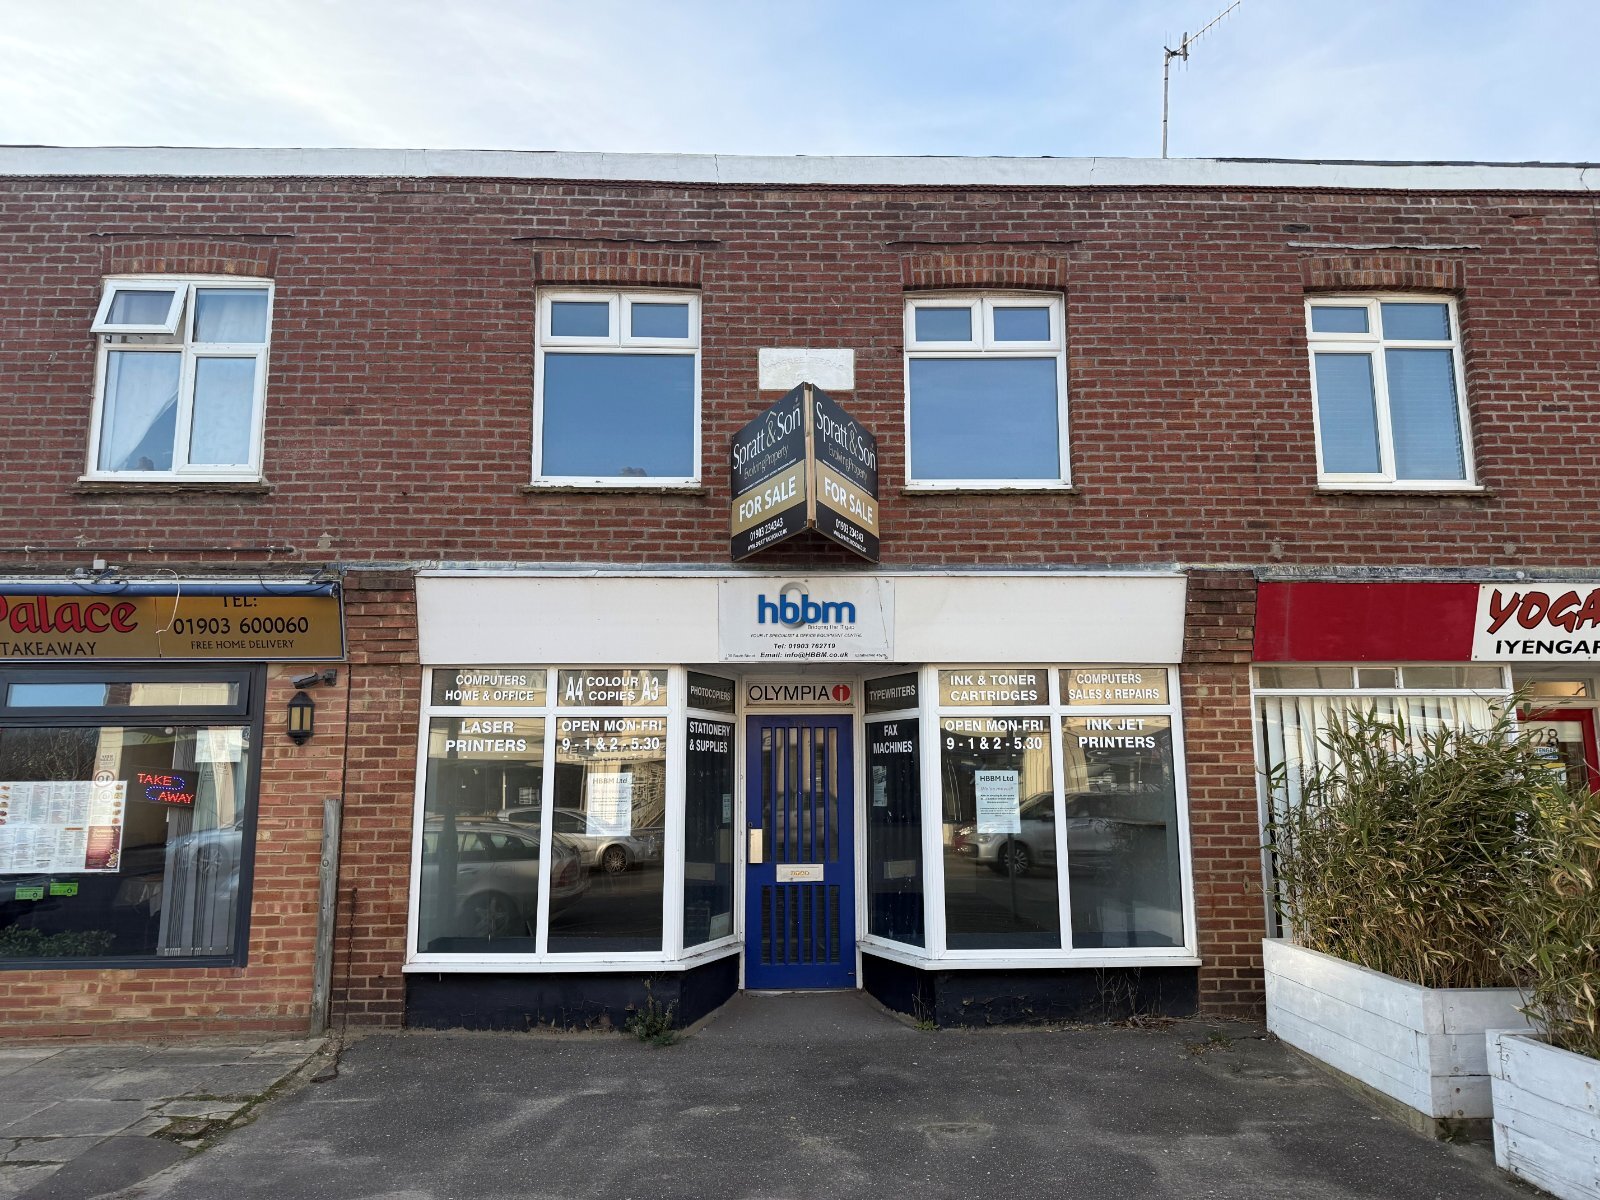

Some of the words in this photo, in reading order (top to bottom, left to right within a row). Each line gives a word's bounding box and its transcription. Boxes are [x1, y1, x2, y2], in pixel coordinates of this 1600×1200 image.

[733, 428, 765, 475] Spratt
[766, 411, 777, 447] &
[777, 407, 800, 441] Son
[816, 401, 848, 451] Spratt
[849, 422, 858, 457] &
[858, 435, 876, 472] Son
[739, 495, 762, 522] FOR
[764, 475, 796, 510] SALE
[824, 476, 847, 508] FOR
[849, 493, 873, 525] SALE
[749, 525, 765, 542] 01903
[758, 594, 856, 624] hbbm
[1486, 587, 1600, 635] YOGA
[173, 617, 231, 635] 01903
[239, 616, 309, 634] 600060
[0, 641, 97, 656] TAKEAWAY
[191, 640, 214, 649] FREE
[216, 640, 246, 649] HOME
[249, 639, 294, 649] DELIVERY
[784, 651, 849, 659] info@HBBM.co.uk
[455, 674, 527, 686] COMPUTERS
[586, 676, 639, 687] COLOUR
[950, 674, 974, 686] INK
[977, 675, 987, 686] &
[989, 674, 1036, 686] TONER
[1076, 673, 1142, 684] COMPUTERS
[445, 689, 480, 701] HOME
[482, 690, 490, 701] &
[493, 690, 535, 701] OFFICE
[565, 676, 583, 701] A4
[641, 676, 660, 701] A3
[690, 685, 731, 701] PHOTOCOPIERS
[749, 685, 830, 701] OLYMPIA
[868, 684, 916, 701] TYPEWRITERS
[950, 689, 1038, 701] CARTRIDGES
[1068, 688, 1102, 700] SALES
[1104, 689, 1112, 699] &
[1114, 688, 1160, 699] REPAIRS
[588, 691, 636, 701] COPIES
[461, 721, 515, 734] LASER
[561, 720, 600, 732] OPEN
[603, 720, 662, 732] MON-FRI
[689, 720, 731, 737] STATIONERY
[883, 723, 898, 736] FAX
[945, 719, 982, 731] OPEN
[986, 719, 1044, 731] MON-FRI
[1086, 718, 1113, 731] INK
[1117, 718, 1145, 731] JET
[445, 739, 527, 752] PRINTERS
[562, 737, 571, 751] 9
[585, 737, 591, 750] 1
[596, 737, 606, 750] &
[610, 737, 618, 750] 2
[631, 737, 660, 750] 5.30
[689, 739, 695, 751] &
[696, 739, 728, 753] SUPPLIES
[873, 740, 913, 754] MACHINES
[946, 737, 955, 750] 9
[968, 737, 974, 750] 1
[979, 736, 989, 750] &
[993, 737, 1001, 750] 2
[1014, 737, 1043, 750] 5.30
[1078, 736, 1156, 749] PRINTERS
[137, 773, 172, 786] TAKE
[157, 791, 194, 804] AWAY
